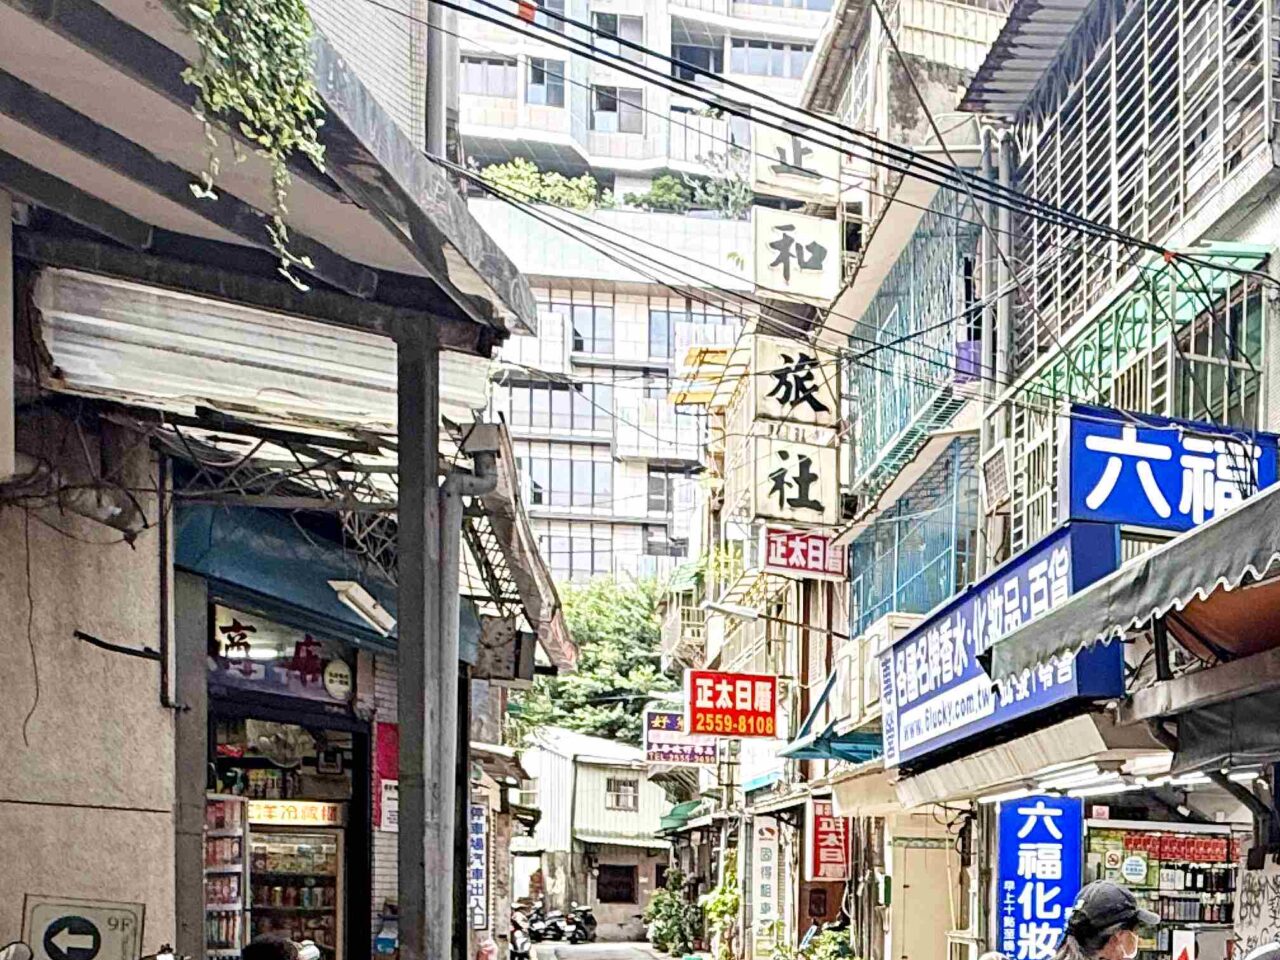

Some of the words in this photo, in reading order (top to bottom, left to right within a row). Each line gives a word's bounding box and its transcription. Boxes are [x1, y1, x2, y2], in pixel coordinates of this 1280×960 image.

[1085, 424, 1262, 525] 六福
[696, 712, 774, 734] 2559-8108
[470, 807, 485, 926] 停車場汽車出入口
[107, 916, 133, 932] 9F
